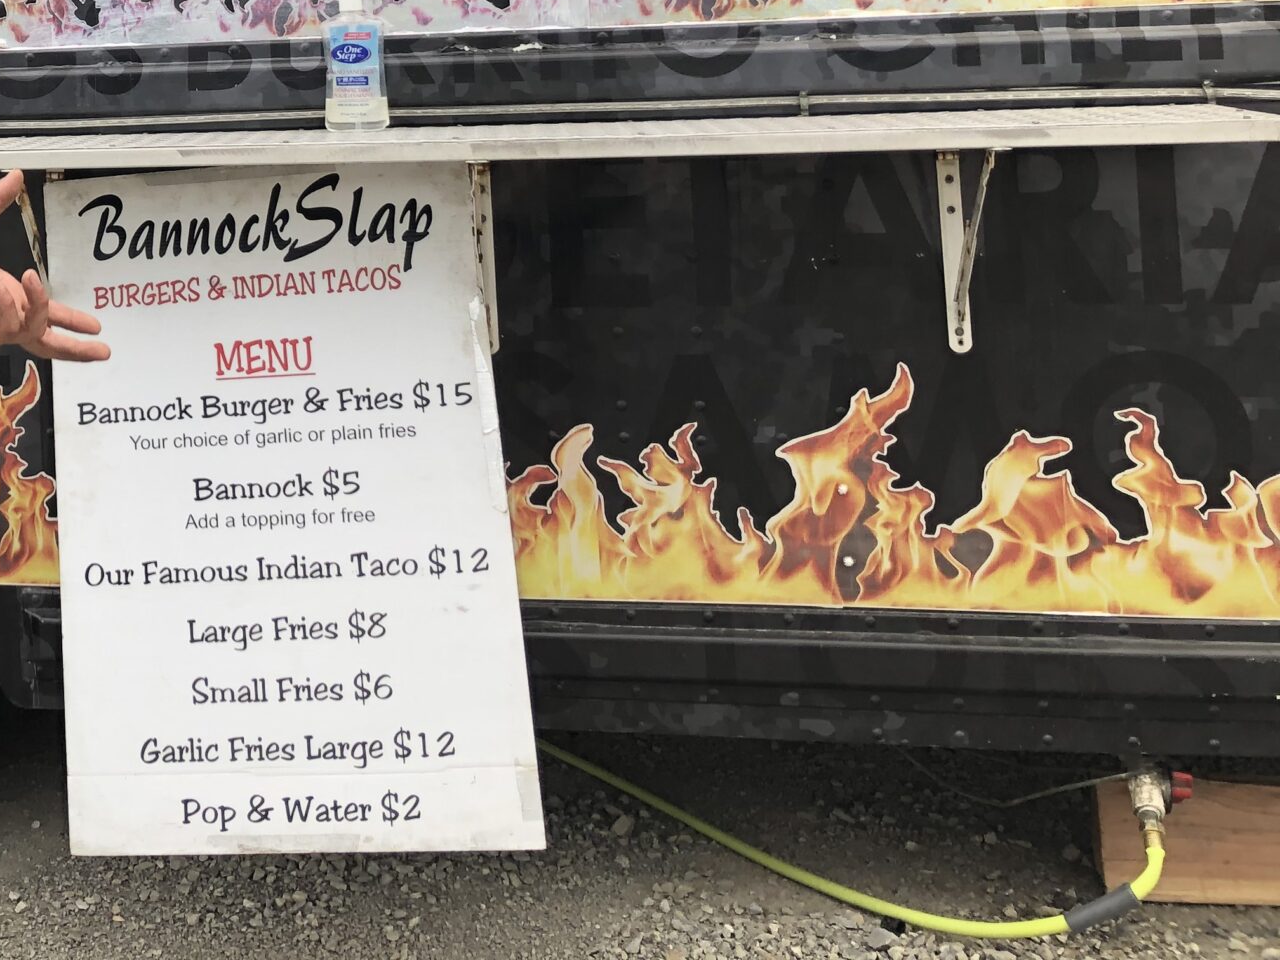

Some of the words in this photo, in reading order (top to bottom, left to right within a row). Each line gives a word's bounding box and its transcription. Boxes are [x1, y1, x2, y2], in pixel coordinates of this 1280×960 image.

[336, 50, 357, 62] Step
[343, 45, 363, 55] One
[77, 173, 433, 271] BannockSlap
[93, 277, 200, 309] BURGERS
[208, 275, 227, 300] &
[232, 271, 315, 299] INDIAN
[322, 263, 402, 292] TACOS
[214, 336, 316, 376] MENU
[77, 397, 193, 425] Bannock
[200, 395, 294, 424] Burger
[303, 387, 329, 413] &
[336, 387, 403, 412] Fries
[413, 379, 472, 413] $15
[129, 435, 167, 450] Your
[174, 433, 228, 448] choice
[234, 430, 250, 445] of
[256, 428, 302, 448] garlic
[308, 430, 325, 441] or
[332, 426, 372, 444] plain
[379, 423, 416, 438] fries
[193, 473, 314, 501] Bannock
[323, 466, 360, 500] $5
[185, 513, 218, 529] Add
[226, 516, 235, 528] a
[241, 513, 305, 530] topping
[312, 509, 335, 524] for
[341, 508, 375, 523] free
[85, 563, 134, 586] Our
[142, 561, 248, 585] Famous
[256, 555, 342, 581] Indian
[350, 552, 418, 577] Taco
[428, 544, 489, 579] $12
[187, 619, 263, 651] Large
[272, 616, 338, 641] Fries
[348, 608, 387, 644] $8
[192, 677, 268, 705] Small
[276, 677, 343, 702] Fries
[354, 669, 393, 705] $6
[140, 738, 219, 764] Garlic
[228, 736, 295, 762] Fries
[304, 735, 383, 769] Large
[394, 727, 455, 764] $12
[181, 799, 236, 832] Pop
[247, 795, 274, 823] &
[282, 796, 371, 823] Water
[381, 789, 421, 827] $2
